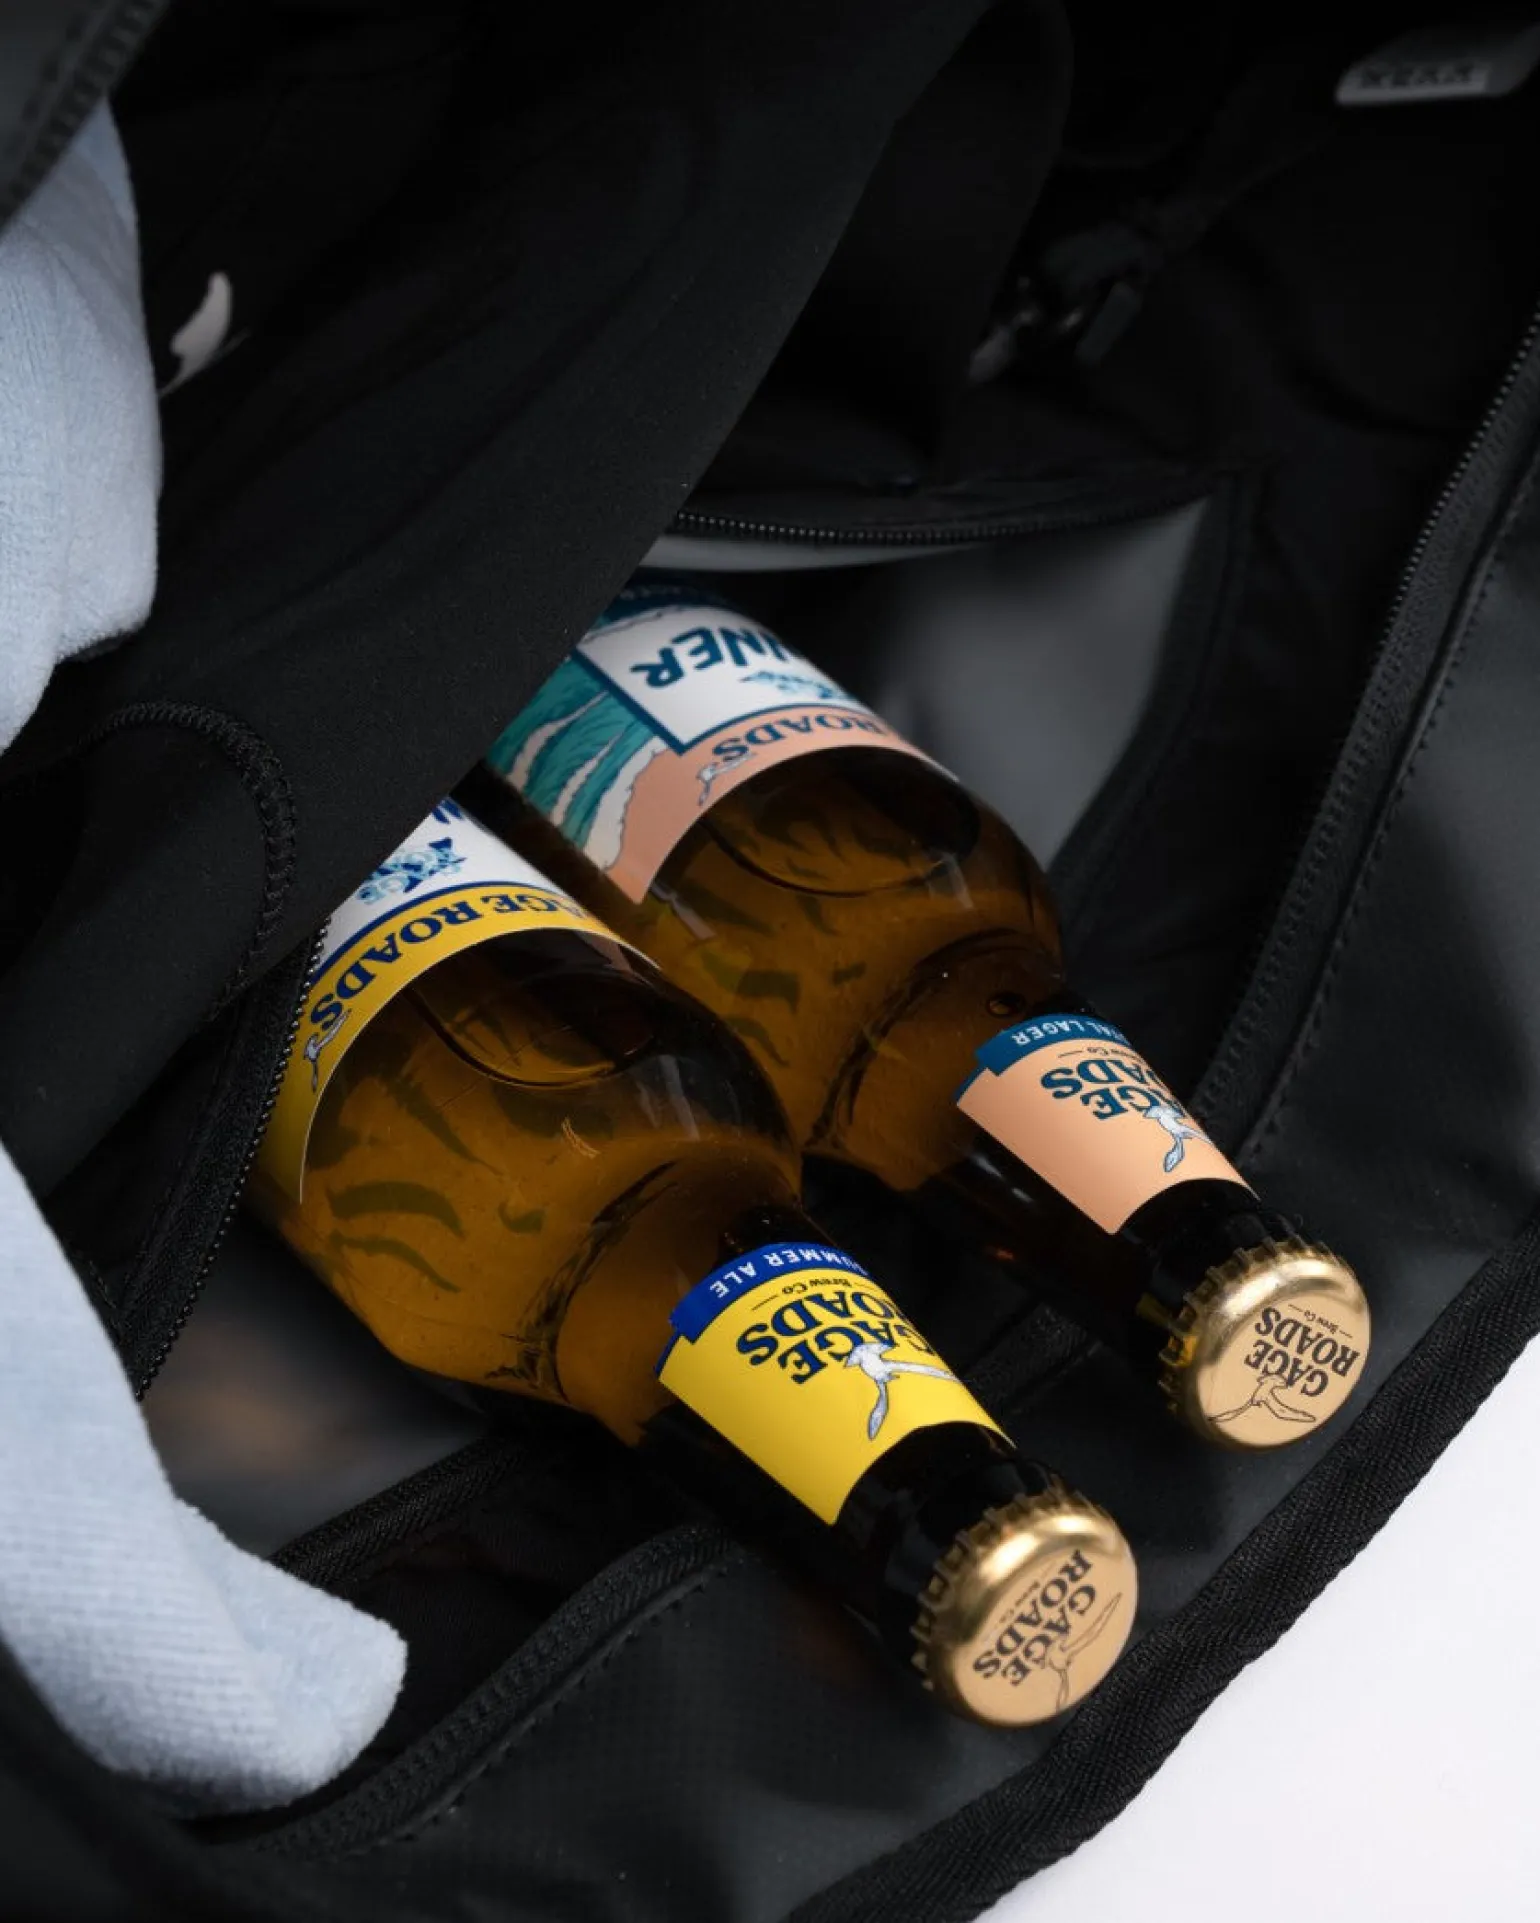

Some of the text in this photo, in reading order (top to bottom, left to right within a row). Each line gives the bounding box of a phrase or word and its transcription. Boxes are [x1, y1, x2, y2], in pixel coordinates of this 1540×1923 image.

[310, 902, 482, 1031] ROADS
[1012, 1019, 1081, 1045] LAGER
[710, 1261, 756, 1298] ALE
[782, 1281, 807, 1294] Co
[1244, 1340, 1328, 1397] GAGE
[1255, 1308, 1360, 1376] ROADS
[972, 1550, 1092, 1679] ROADS
[1002, 1585, 1096, 1687] GAGE
